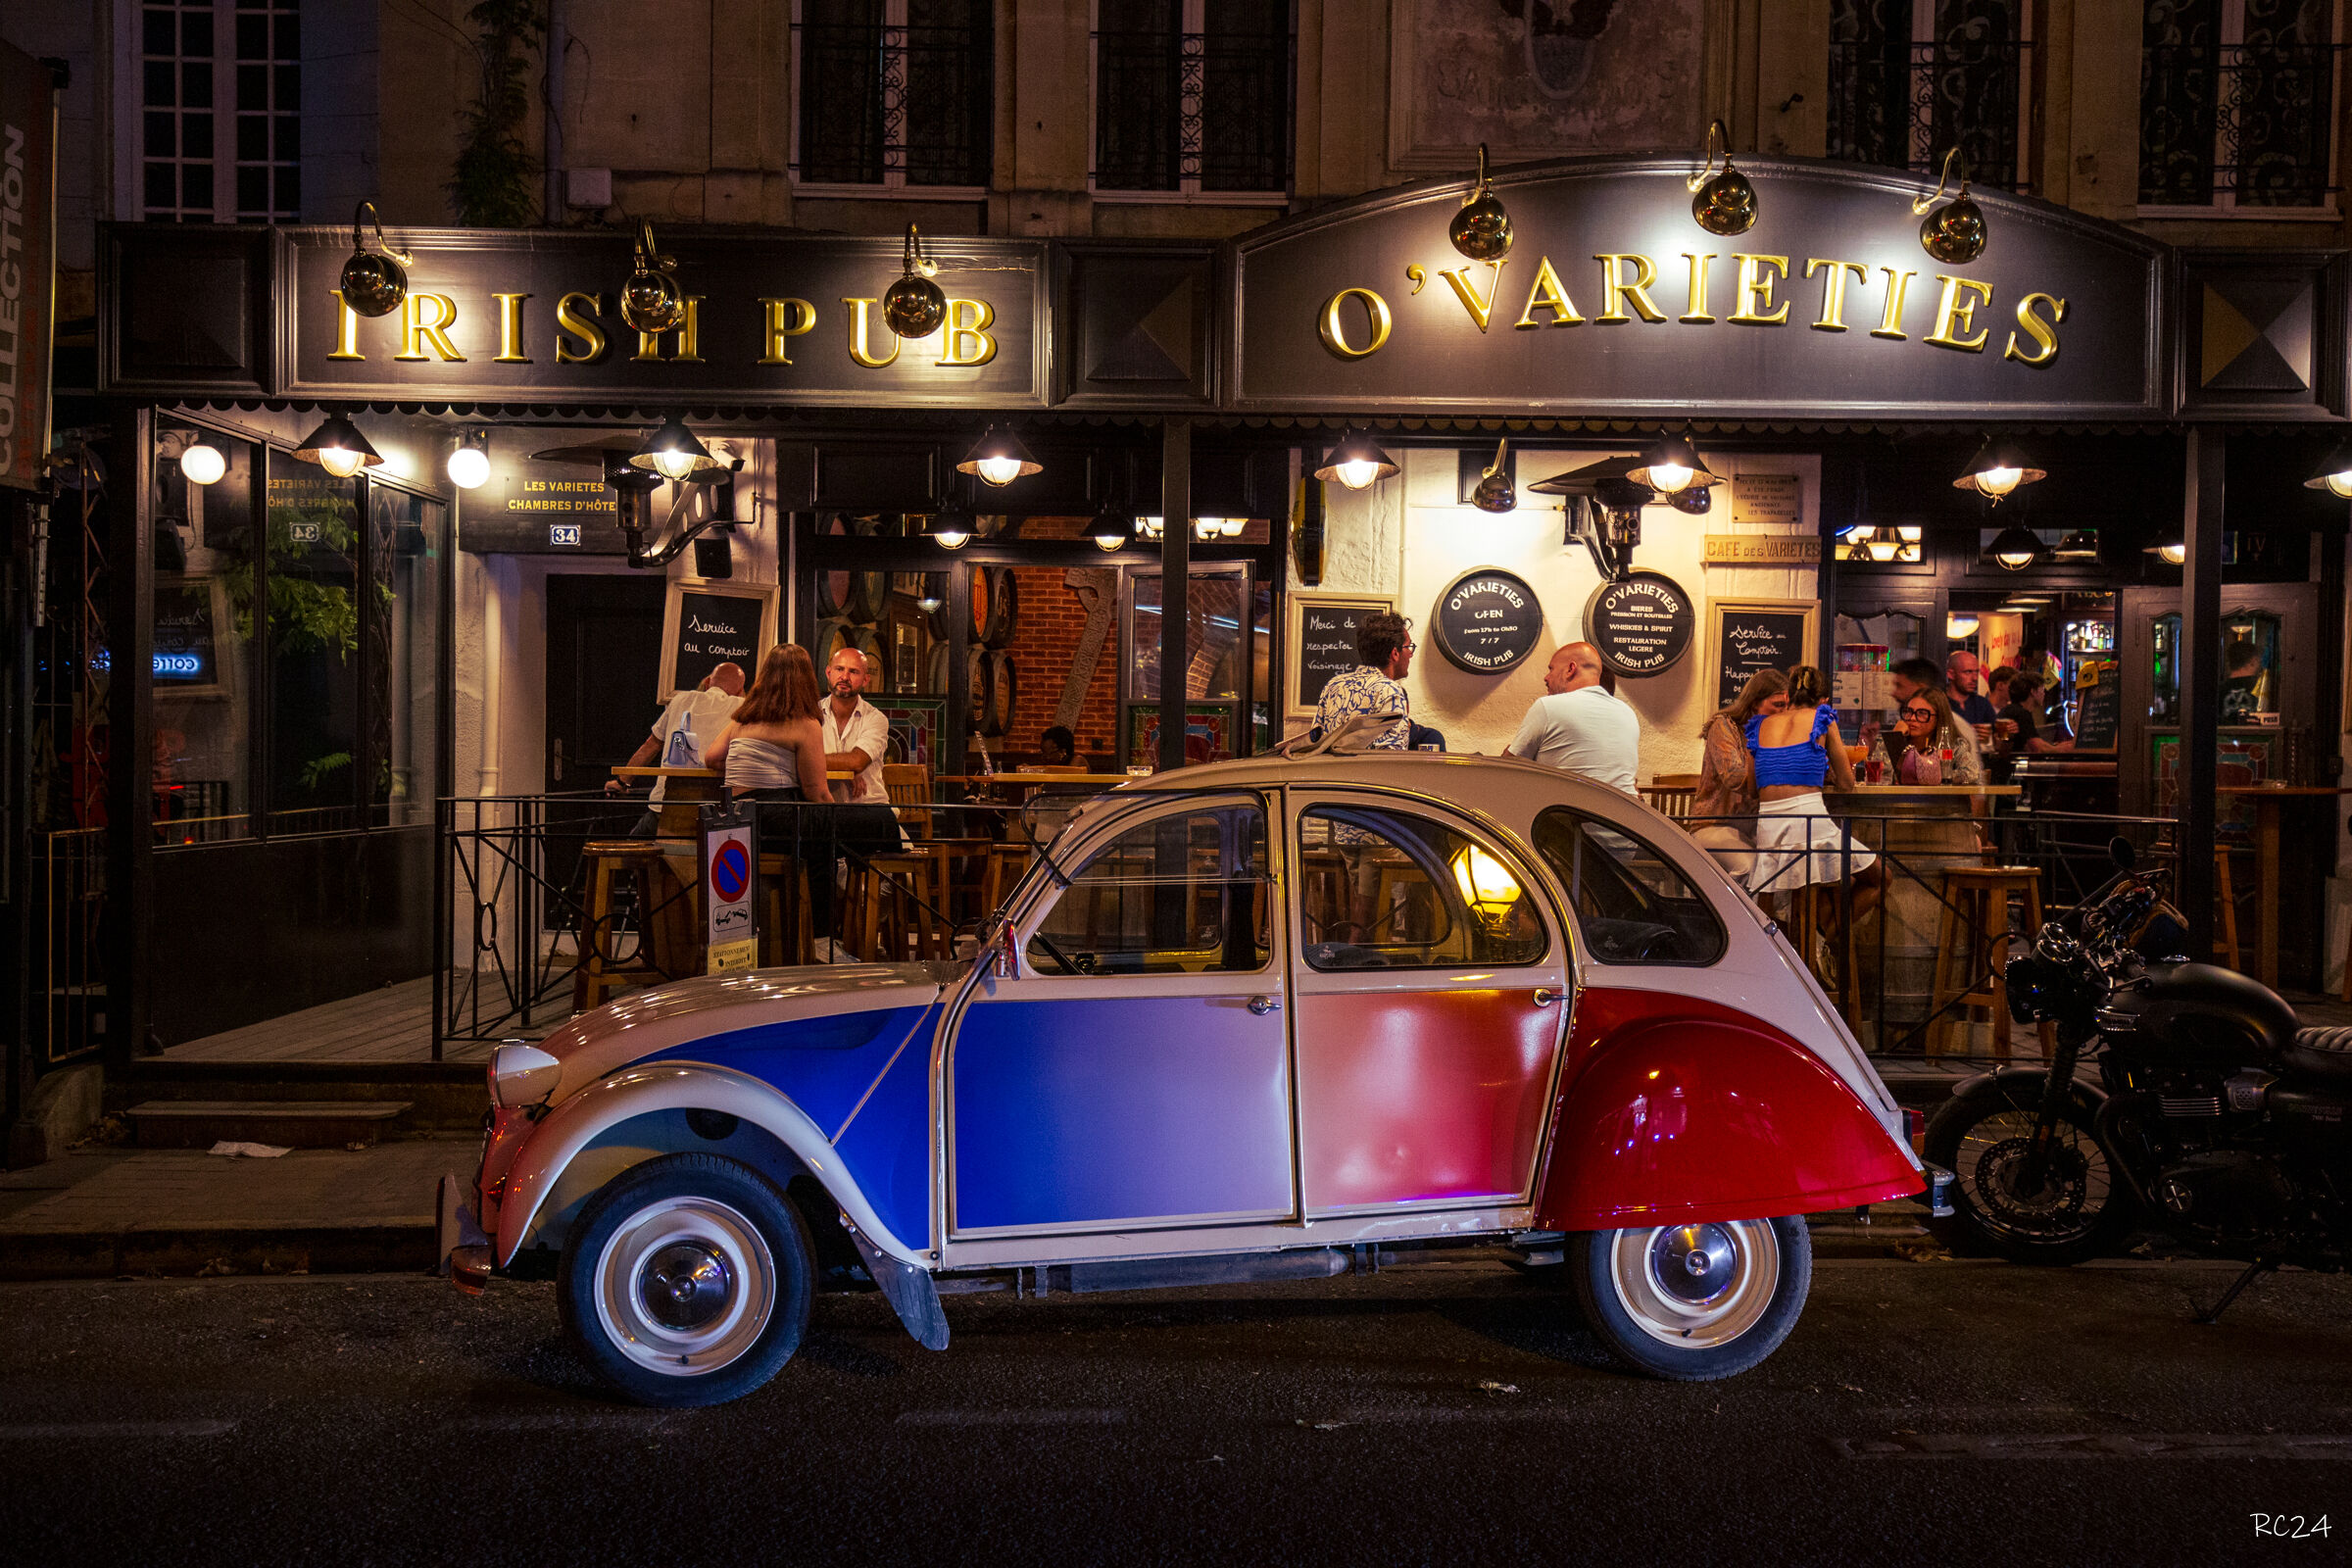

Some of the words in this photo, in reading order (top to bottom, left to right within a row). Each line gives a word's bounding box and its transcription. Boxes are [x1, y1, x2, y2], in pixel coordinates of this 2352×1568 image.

[0, 123, 24, 478] COLLECTION
[1318, 252, 2067, 366] O'VARIETIES
[326, 289, 707, 363] IRISH
[758, 297, 999, 368] PUB
[524, 481, 546, 492] LES
[549, 481, 605, 493] VARIETES
[508, 499, 571, 511] CHAMBRES
[555, 528, 576, 543] 34
[1450, 581, 1525, 611] O'VARIETIES
[1605, 583, 1679, 613] O'VARIETIES
[1309, 614, 1337, 631] Merci
[1344, 615, 1356, 629] de
[1474, 610, 1503, 619] OPEN
[688, 614, 737, 633] Service
[1729, 624, 1774, 640] Service
[1306, 639, 1353, 656] respecter
[1613, 637, 1668, 646] RESTAURATION
[684, 642, 701, 654] au
[708, 644, 751, 660] comptoir
[1463, 651, 1492, 666] IRISH
[1494, 649, 1514, 665] PUB
[1614, 651, 1642, 668] IRISH
[1644, 653, 1665, 668] PUB
